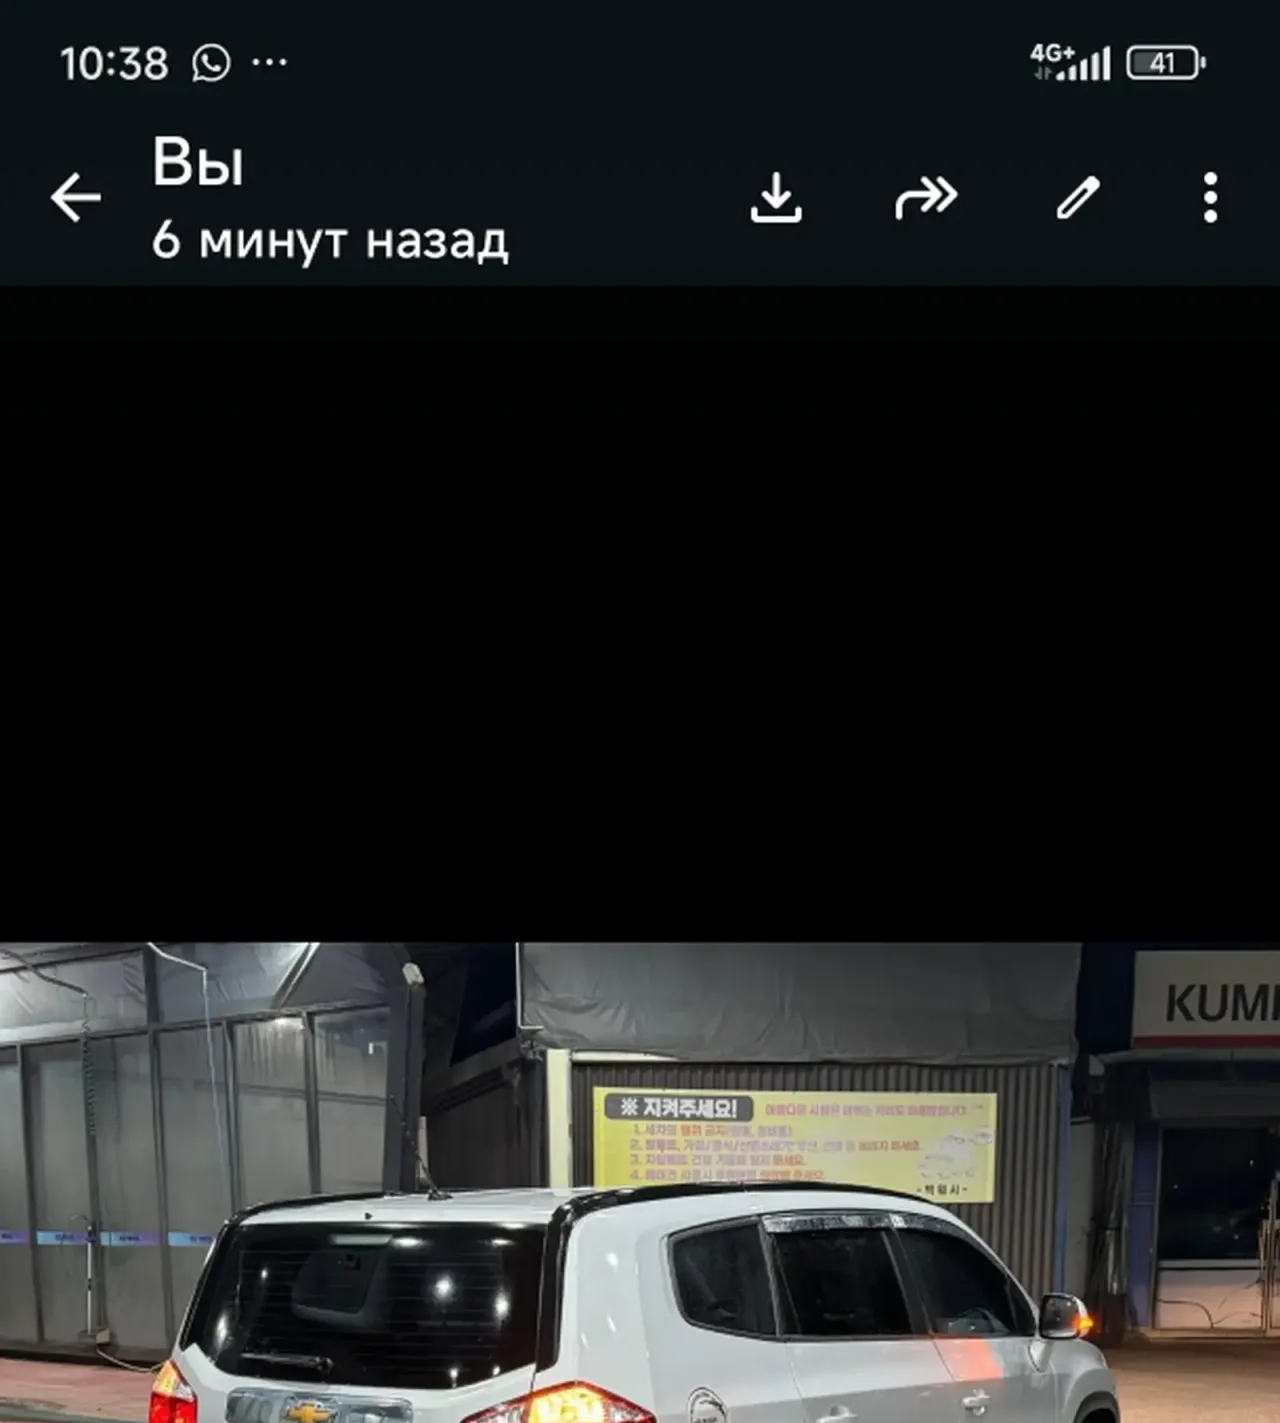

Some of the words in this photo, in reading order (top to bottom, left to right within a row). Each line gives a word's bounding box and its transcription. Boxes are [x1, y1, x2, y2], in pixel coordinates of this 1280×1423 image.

[61, 46, 168, 80] 10:38
[1030, 43, 1075, 62] 4G+
[1149, 52, 1175, 73] 41
[155, 136, 242, 185] Вы
[153, 219, 180, 258] 6
[201, 229, 348, 268] минут
[368, 229, 509, 265] назад
[643, 1098, 738, 1118] 지켜주세요!
